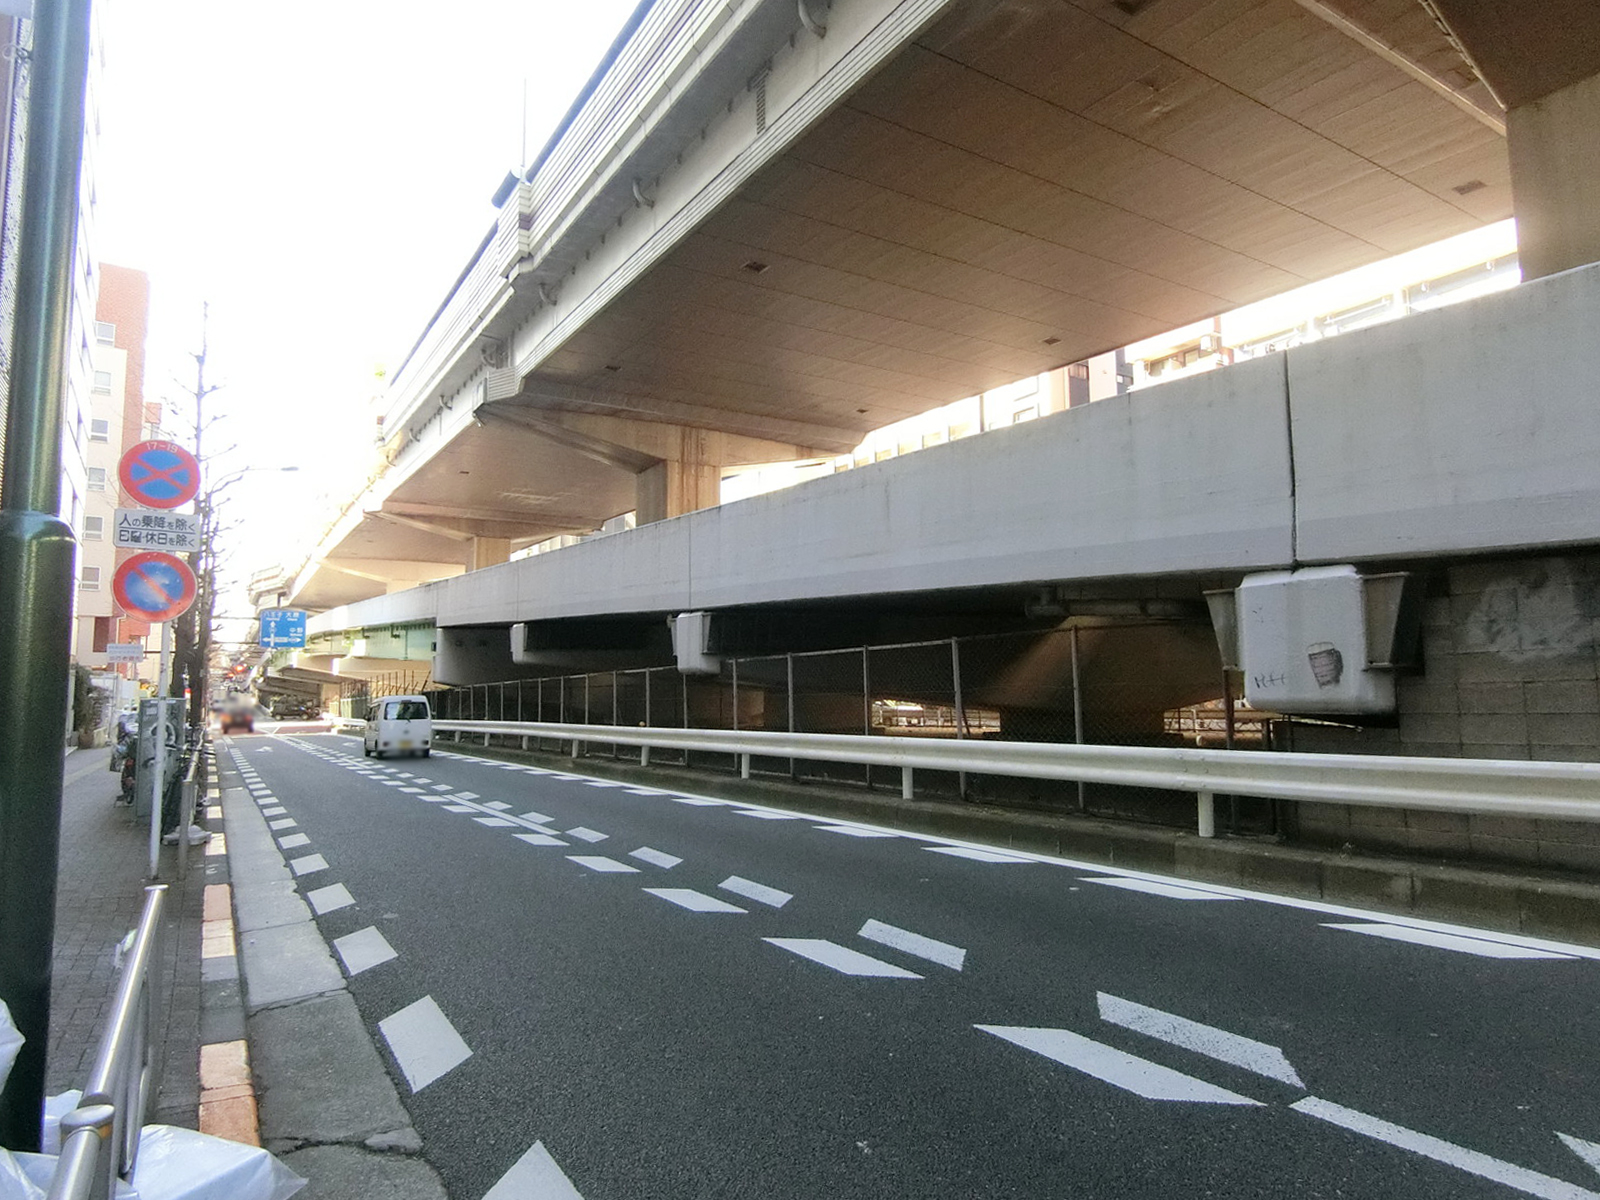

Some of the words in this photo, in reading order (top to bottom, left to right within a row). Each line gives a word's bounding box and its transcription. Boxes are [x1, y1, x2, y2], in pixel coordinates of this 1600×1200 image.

[146, 441, 179, 453] 17-19
[118, 513, 196, 532] 人の乗降を除く
